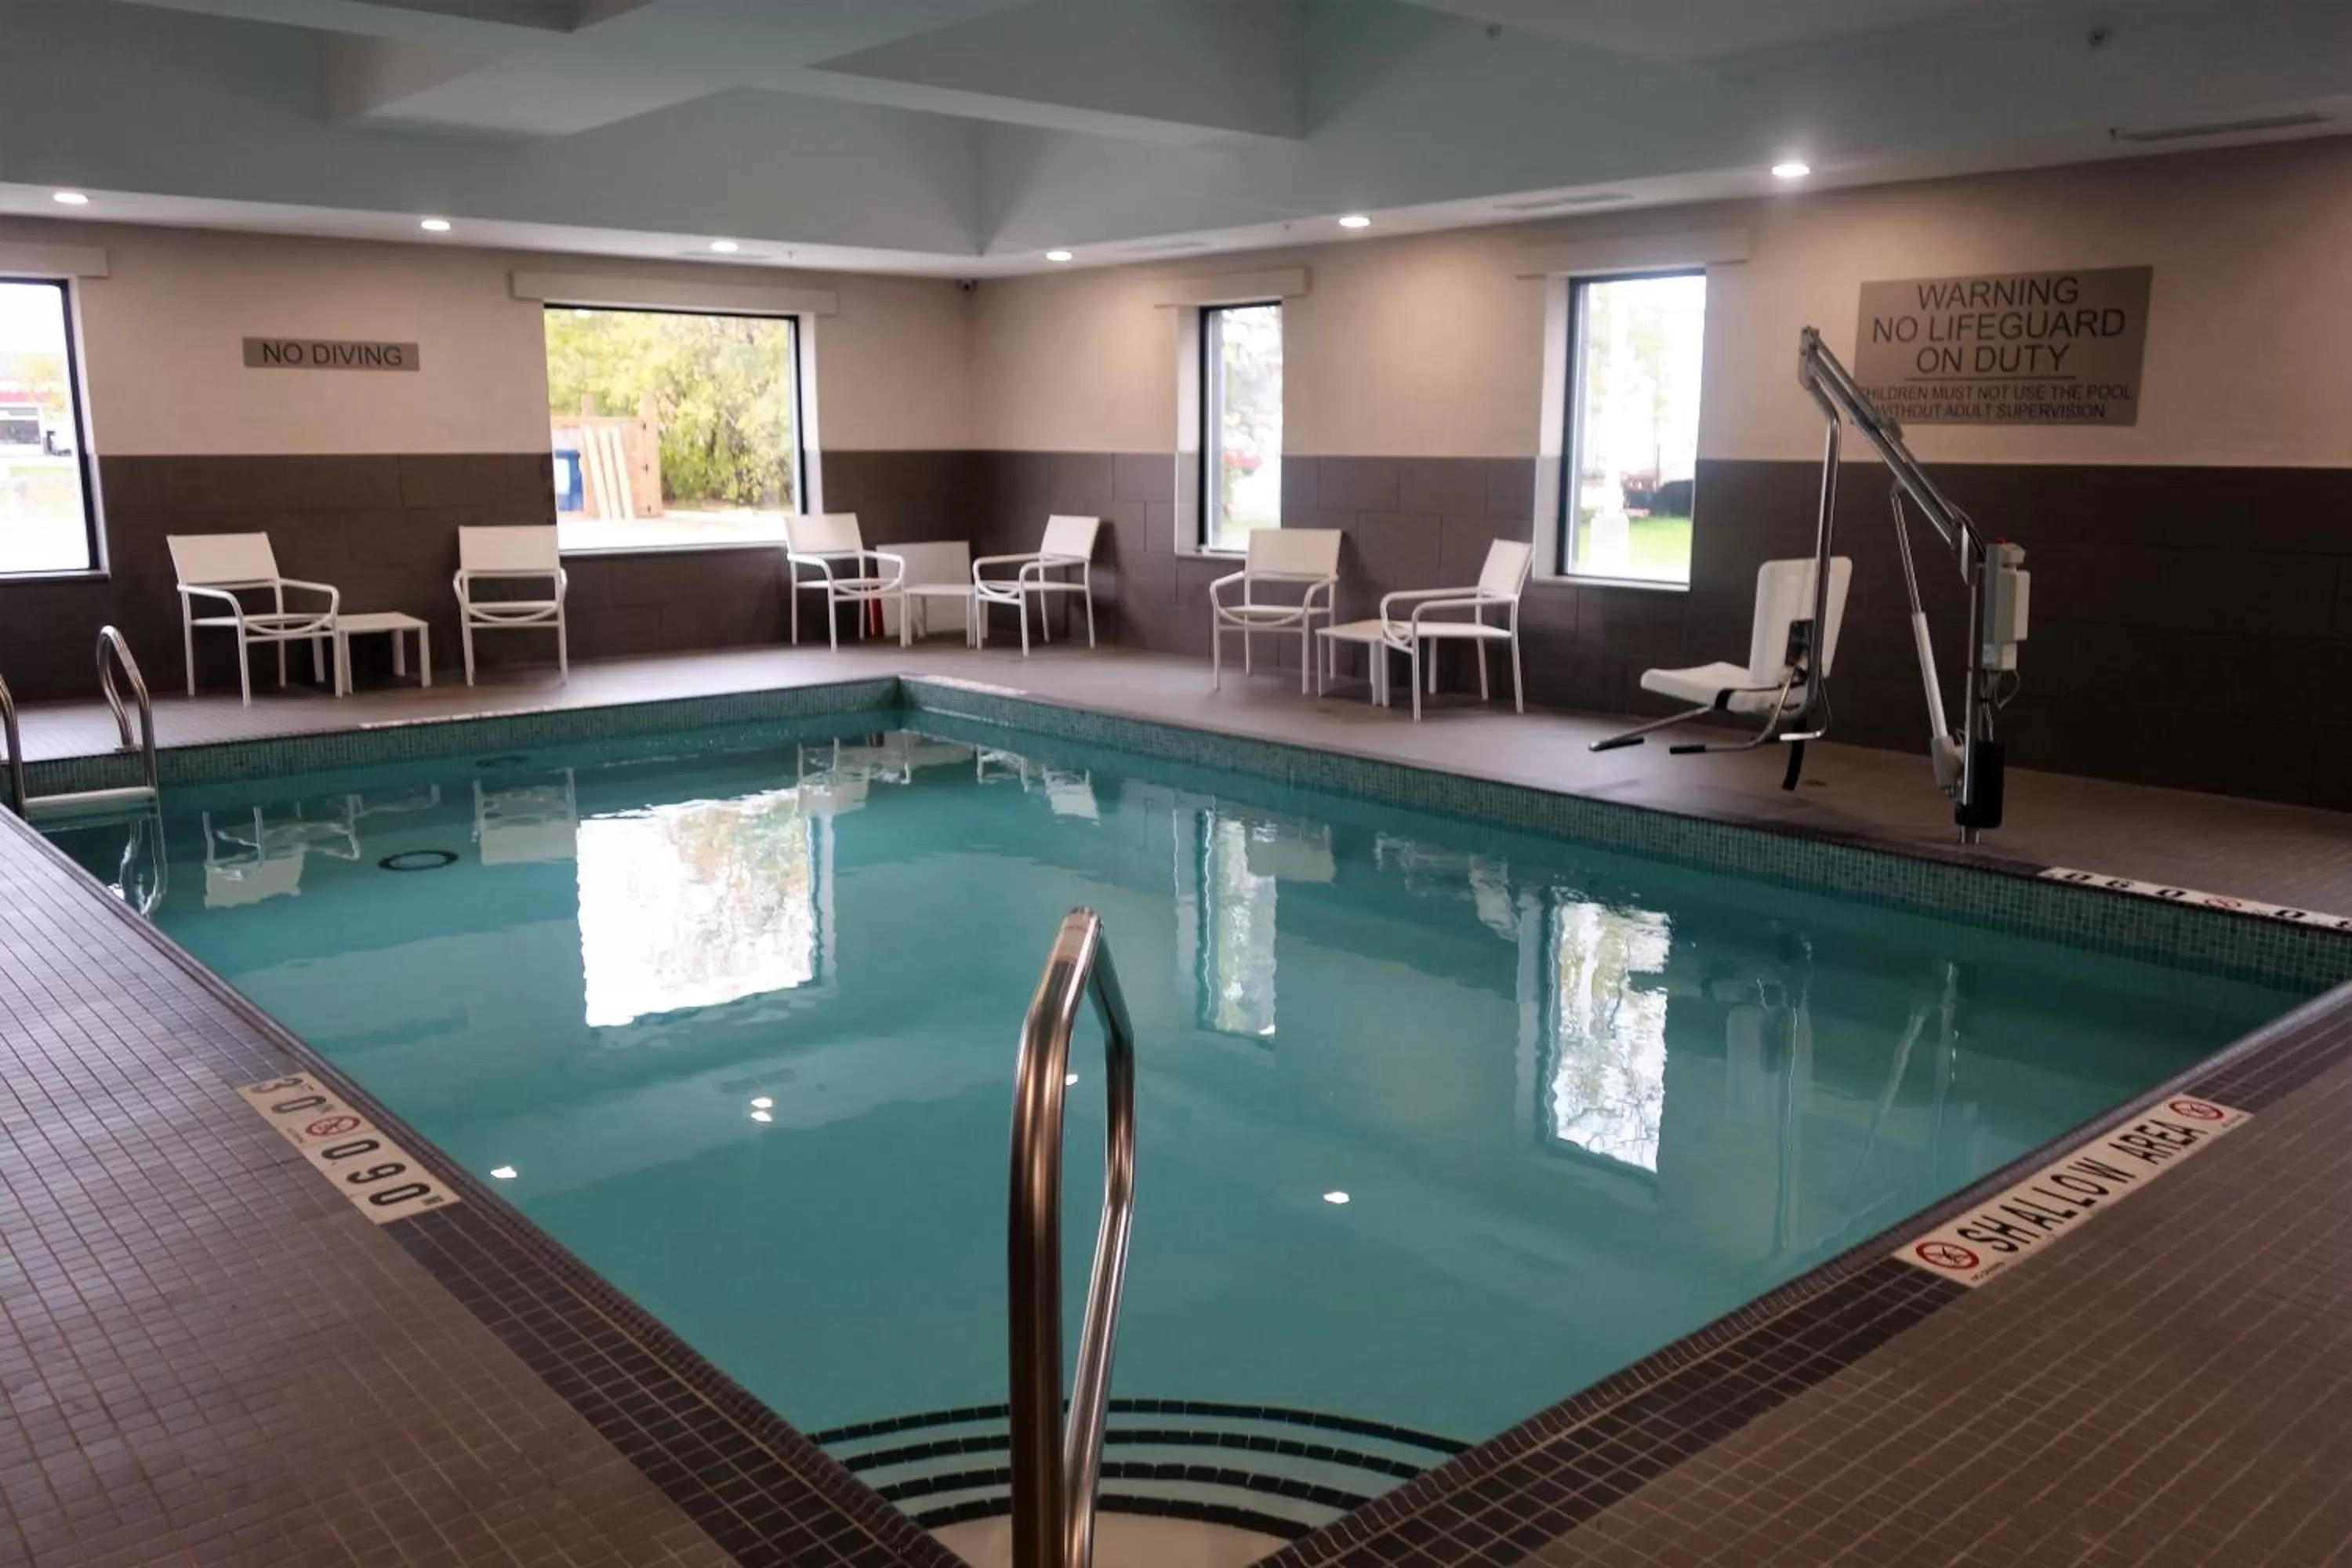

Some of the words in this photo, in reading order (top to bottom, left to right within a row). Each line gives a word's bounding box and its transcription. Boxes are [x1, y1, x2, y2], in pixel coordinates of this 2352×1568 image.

[1918, 277, 2079, 310] WARNING
[1872, 317, 1918, 343] NO
[1929, 309, 2125, 343] LIFEGUARD
[263, 343, 303, 364] NO
[312, 345, 402, 366] DIVING
[1916, 347, 1962, 375] ON
[1975, 343, 2071, 372] DUTY
[1932, 386, 1973, 401] MUST
[1977, 385, 2009, 400] NOT
[2014, 384, 2045, 400] USE
[2051, 384, 2082, 400] THE
[2086, 383, 2131, 401] POOL
[1944, 403, 1992, 419] ADULT
[1996, 402, 2107, 419] SUPERVISION
[1957, 1157, 2136, 1254] SHALLOW
[2109, 1120, 2208, 1166] AREA
